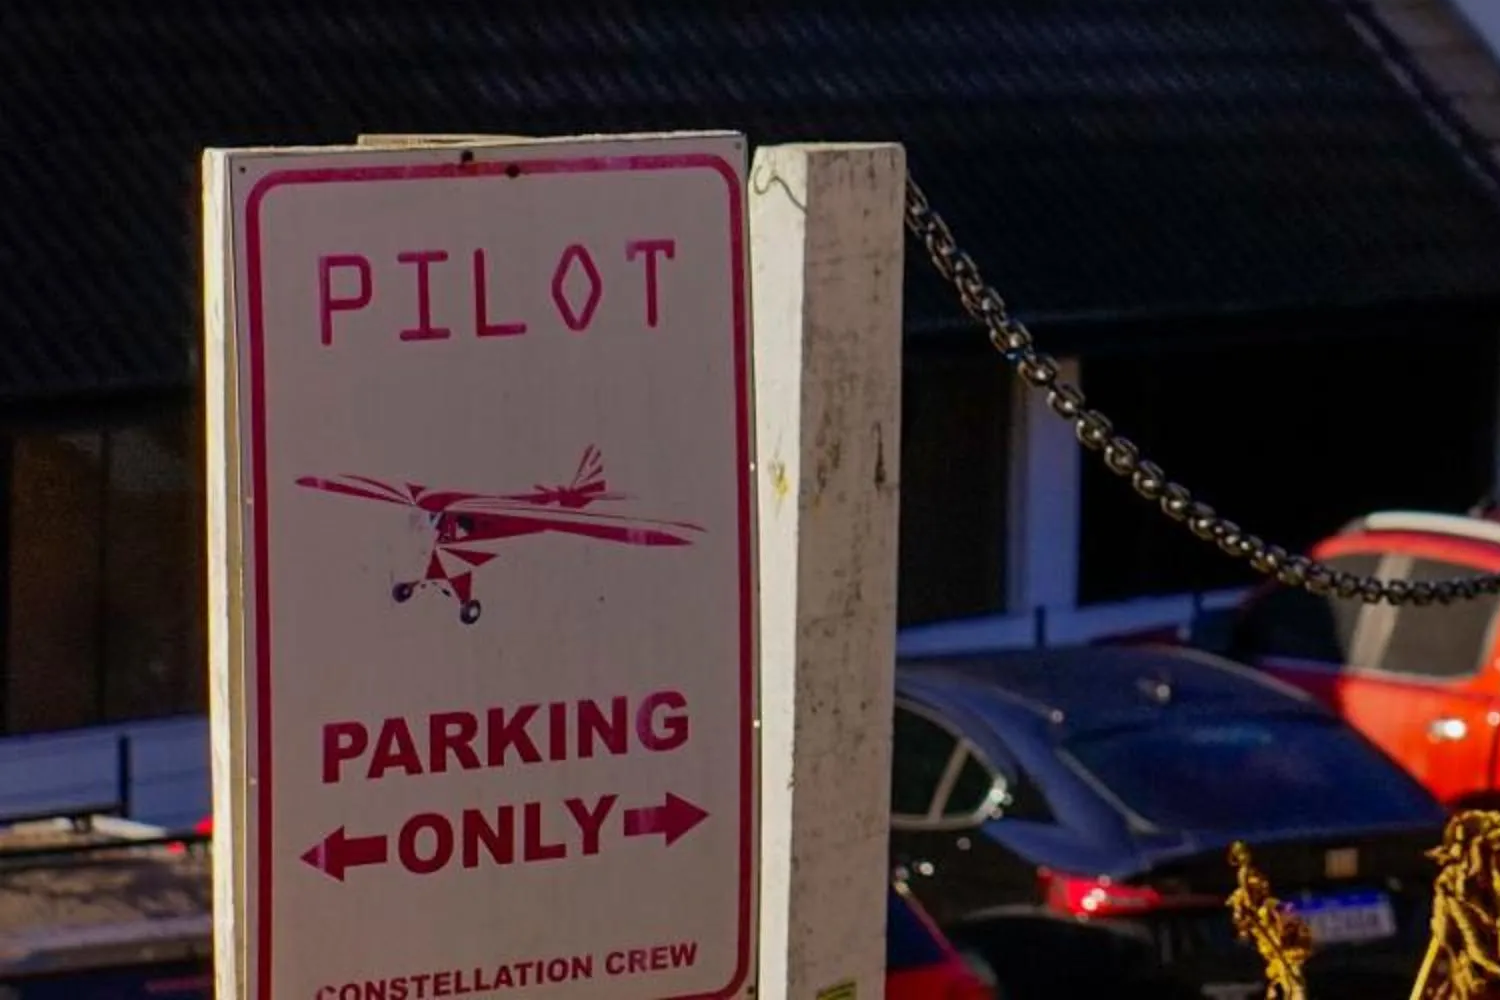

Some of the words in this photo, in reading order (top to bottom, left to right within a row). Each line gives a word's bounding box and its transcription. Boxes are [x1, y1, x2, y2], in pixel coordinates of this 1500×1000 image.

[316, 239, 676, 346] PILOT
[321, 689, 691, 785] PARKING
[397, 794, 617, 876] ONLY
[606, 941, 699, 976] CREW
